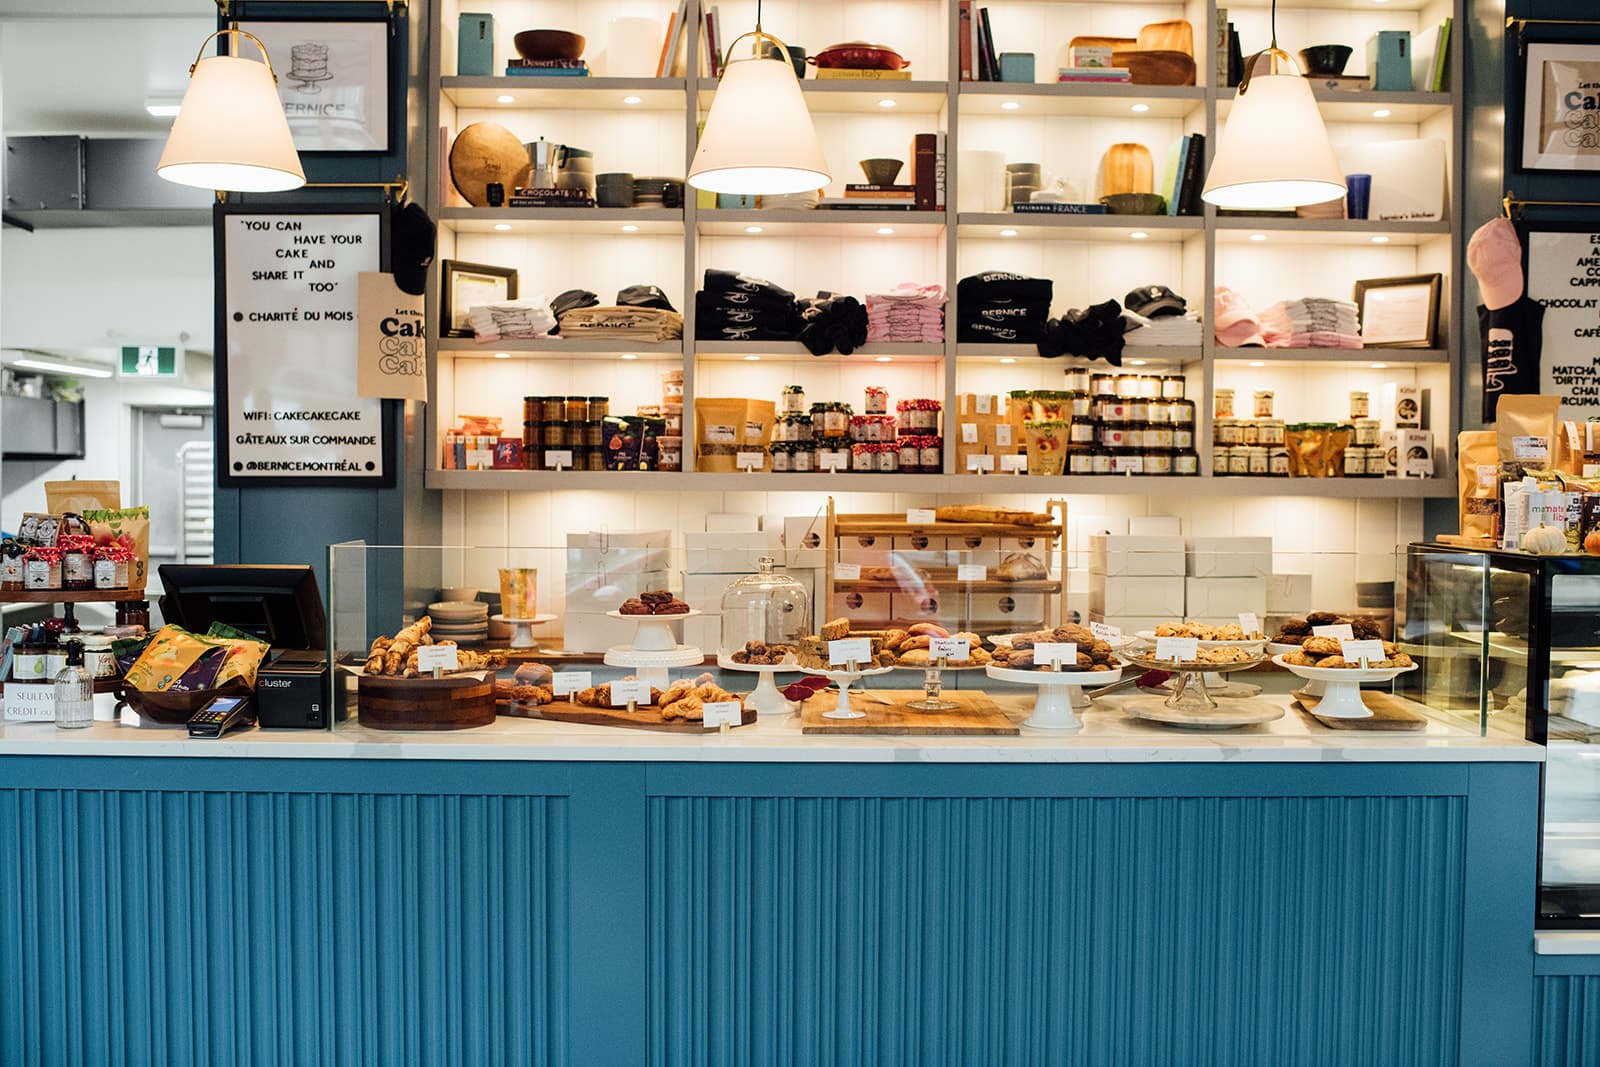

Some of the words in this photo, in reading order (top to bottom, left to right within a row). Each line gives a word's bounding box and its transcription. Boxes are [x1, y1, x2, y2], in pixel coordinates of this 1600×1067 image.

[1564, 91, 1600, 111] Ca
[282, 103, 345, 115] ERNICE
[1053, 204, 1087, 213] FRANCE
[276, 221, 302, 231] CAN
[294, 235, 326, 245] HAVE
[331, 235, 362, 245] YOUR
[275, 249, 308, 258] CAKE
[1592, 247, 1600, 256] A
[309, 260, 335, 269] AND
[252, 271, 288, 281] SHARE
[294, 271, 304, 280] IT
[1538, 299, 1598, 308] CHOCOLAT
[249, 308, 298, 321] CHARITÉ
[304, 311, 321, 321] DU
[325, 311, 353, 321] MOIS
[1552, 366, 1597, 375] MATCHA
[1560, 397, 1600, 406] RCUMA
[274, 411, 361, 421] CAKECAKECAKE
[236, 433, 287, 445] GÂTEAUX
[290, 435, 310, 445] SUR
[312, 435, 377, 446] COMMANDE
[246, 459, 362, 472] @BERNICEMONTRÉAL
[258, 678, 292, 688] cluster
[17, 690, 56, 701] SEULEM
